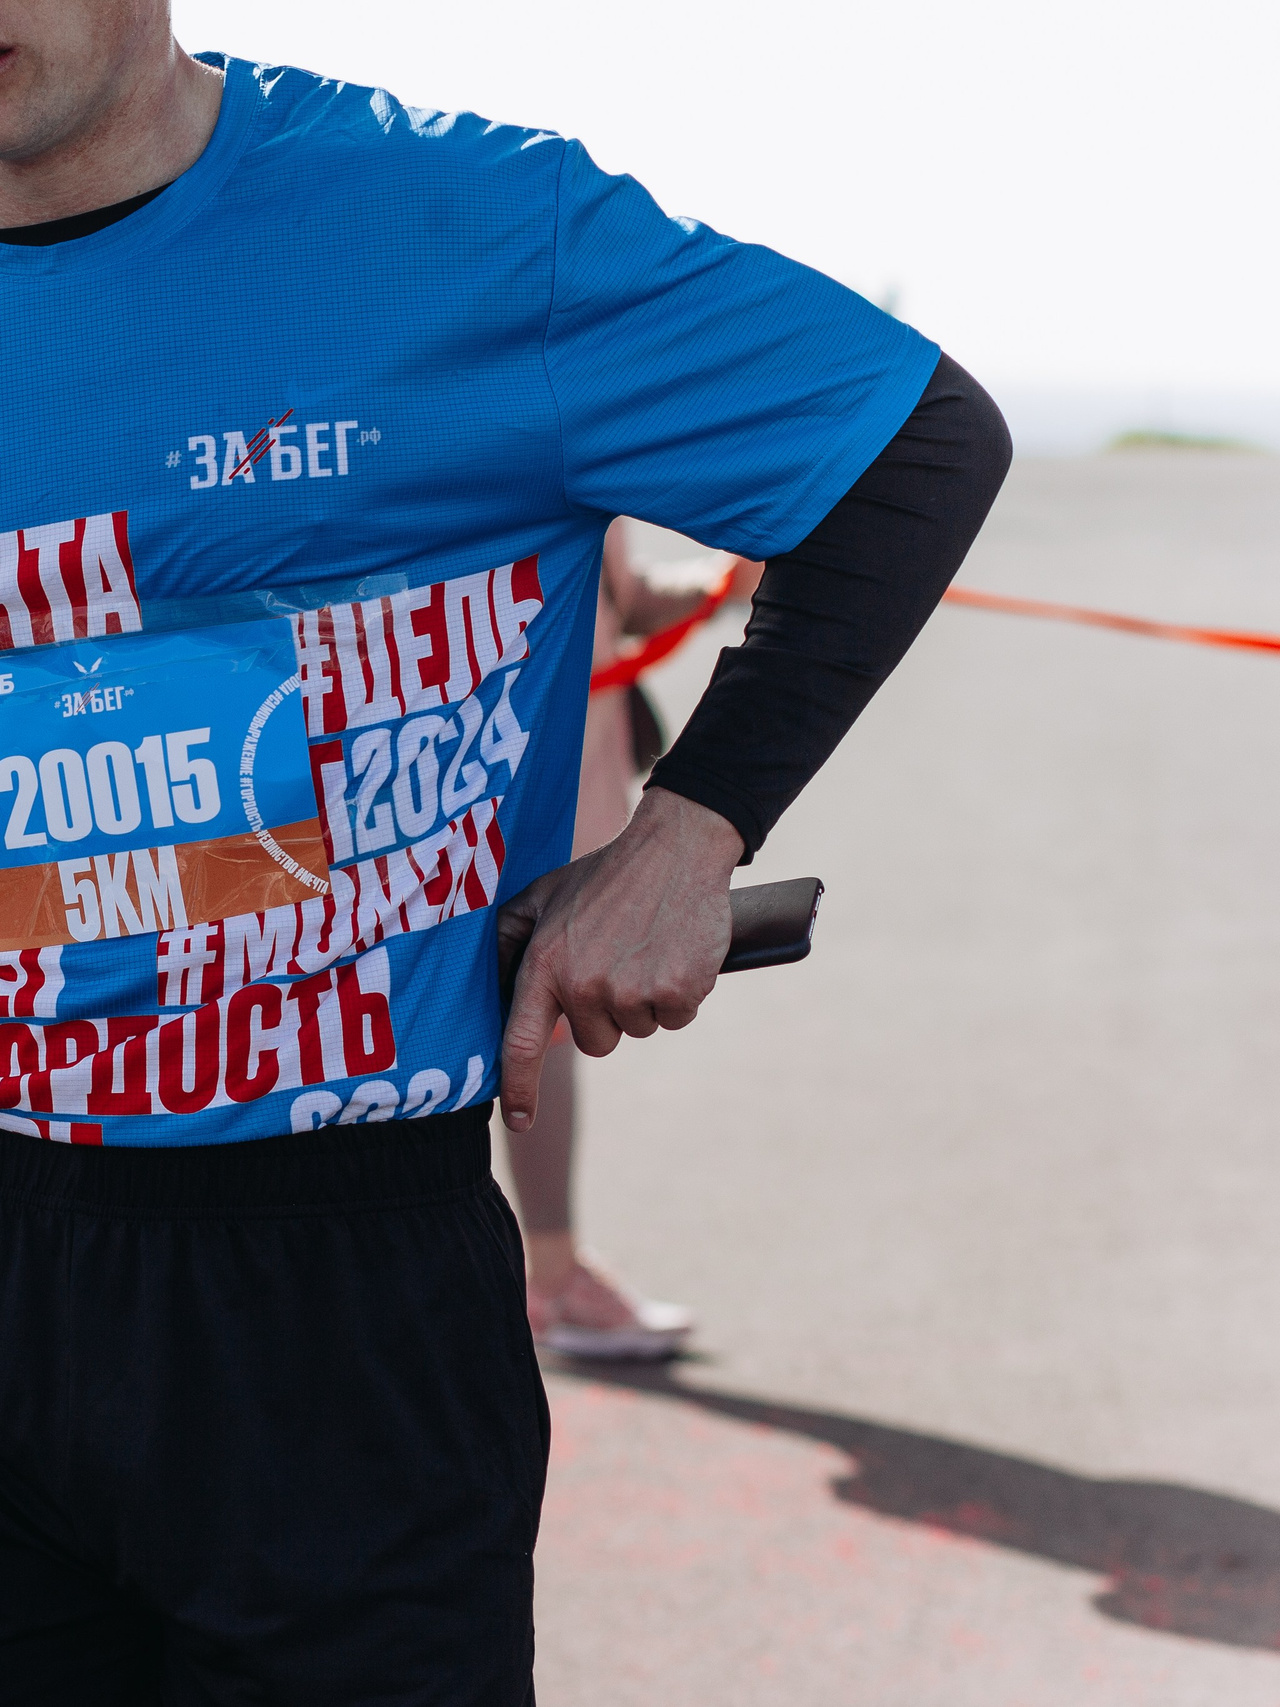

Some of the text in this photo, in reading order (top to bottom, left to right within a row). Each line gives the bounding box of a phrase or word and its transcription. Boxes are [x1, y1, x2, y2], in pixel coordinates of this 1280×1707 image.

[292, 560, 545, 737] #ЦЕЛЬ
[239, 777, 264, 832] #ГОРДОСТЬ
[255, 829, 299, 874] #ЕДИНСТВО
[293, 867, 329, 895] #МЕЧТА
[351, 668, 530, 855] 2024
